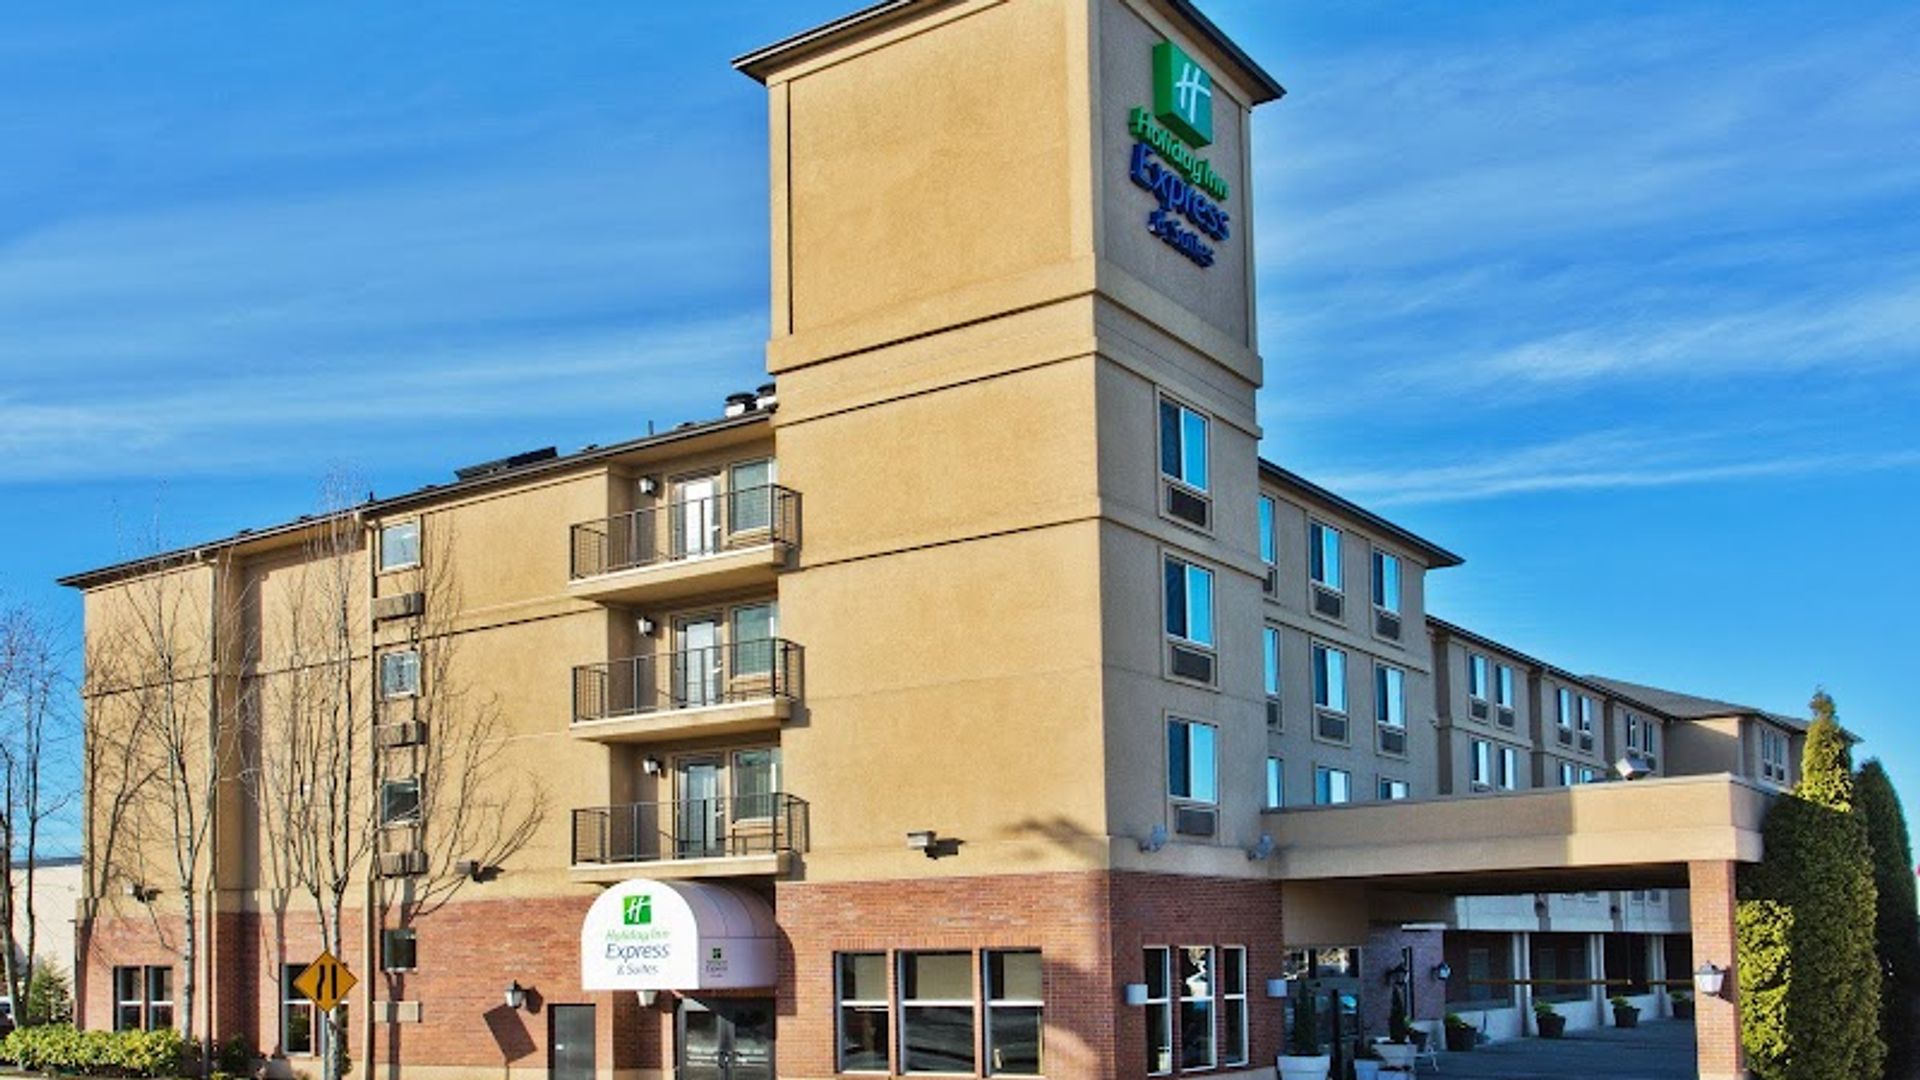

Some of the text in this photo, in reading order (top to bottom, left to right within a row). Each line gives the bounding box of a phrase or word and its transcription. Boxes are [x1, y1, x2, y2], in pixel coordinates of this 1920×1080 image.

[1130, 106, 1229, 200] Holiday Inn
[1131, 143, 1230, 240] Express
[605, 927, 671, 943] Holiday Inn
[605, 943, 671, 963] Express
[626, 962, 660, 976] Suites
